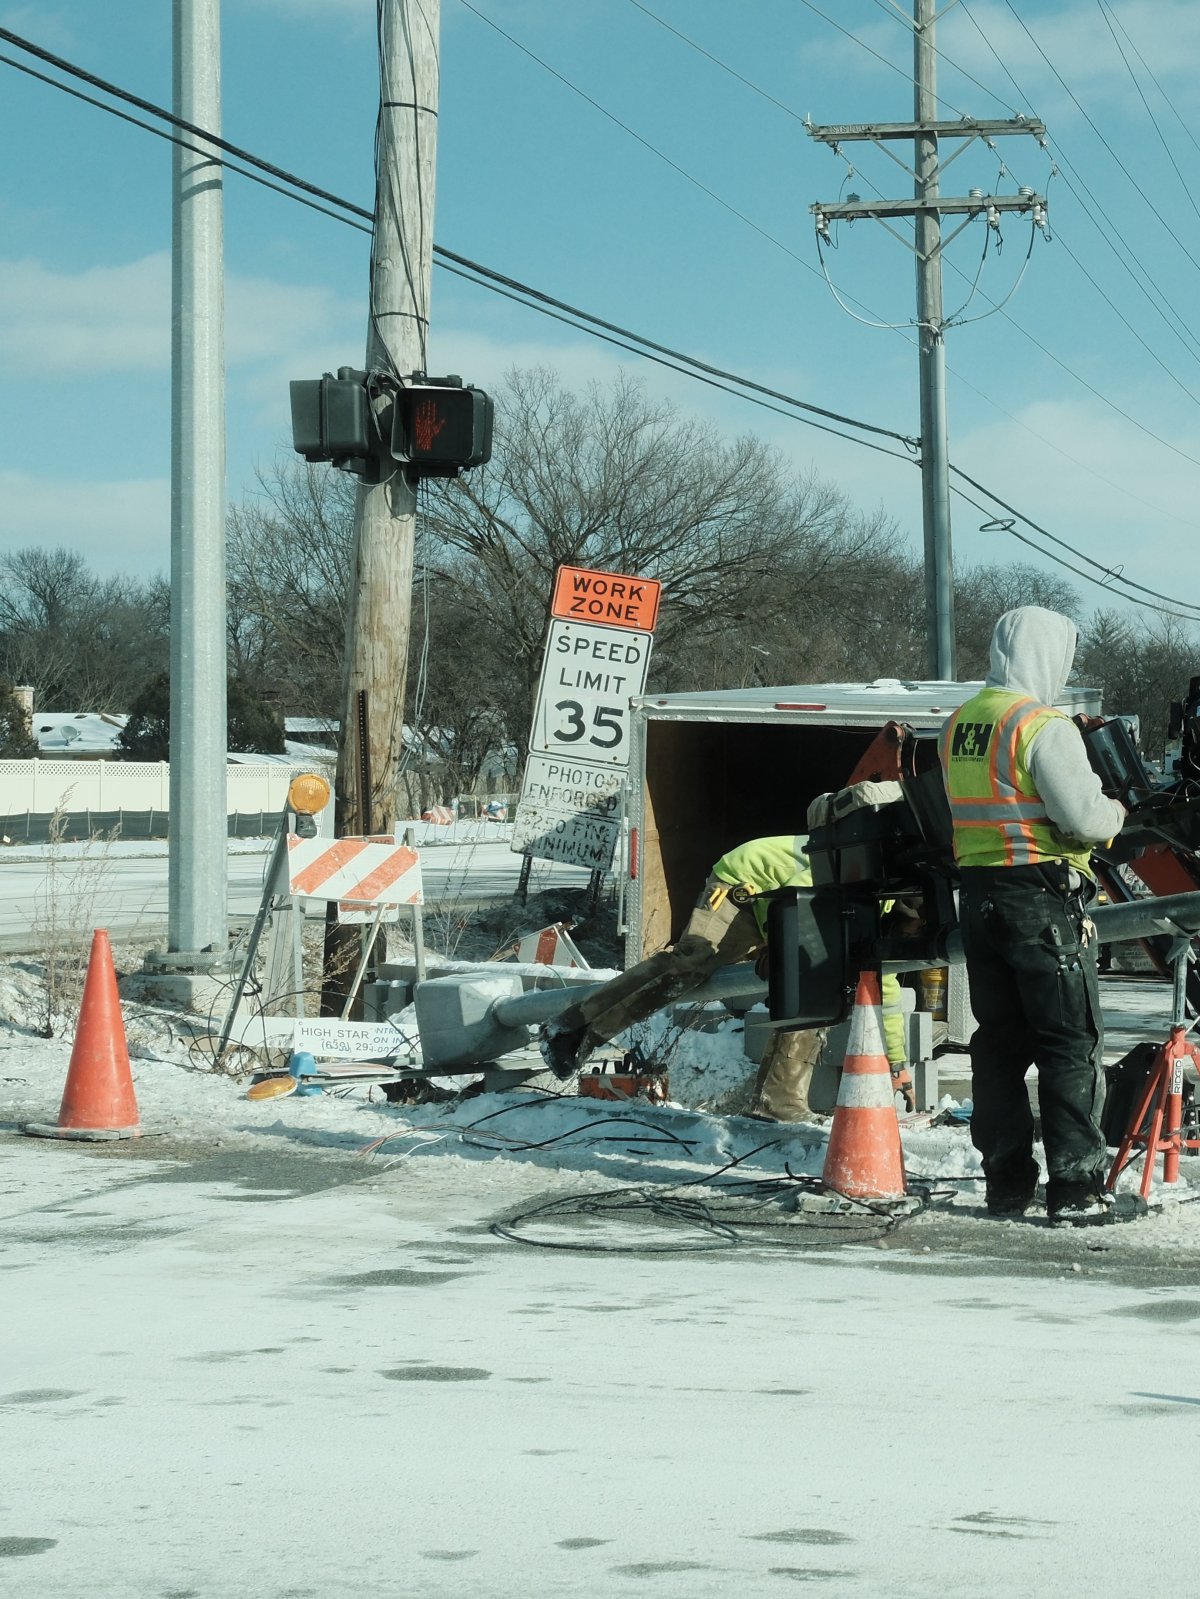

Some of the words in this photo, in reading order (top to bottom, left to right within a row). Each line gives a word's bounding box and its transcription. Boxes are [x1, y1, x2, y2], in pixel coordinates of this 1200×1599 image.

[573, 576, 644, 602] WORK
[570, 596, 640, 622] ZONE
[556, 635, 641, 665] SPEED
[559, 667, 627, 695] LIMIT
[553, 699, 624, 750] 35
[548, 764, 606, 789] PHOTO
[525, 782, 618, 812] ENFORCD
[301, 1027, 332, 1038] HIGH
[337, 1029, 370, 1040] STAR
[1173, 1059, 1183, 1094] RIDGID
